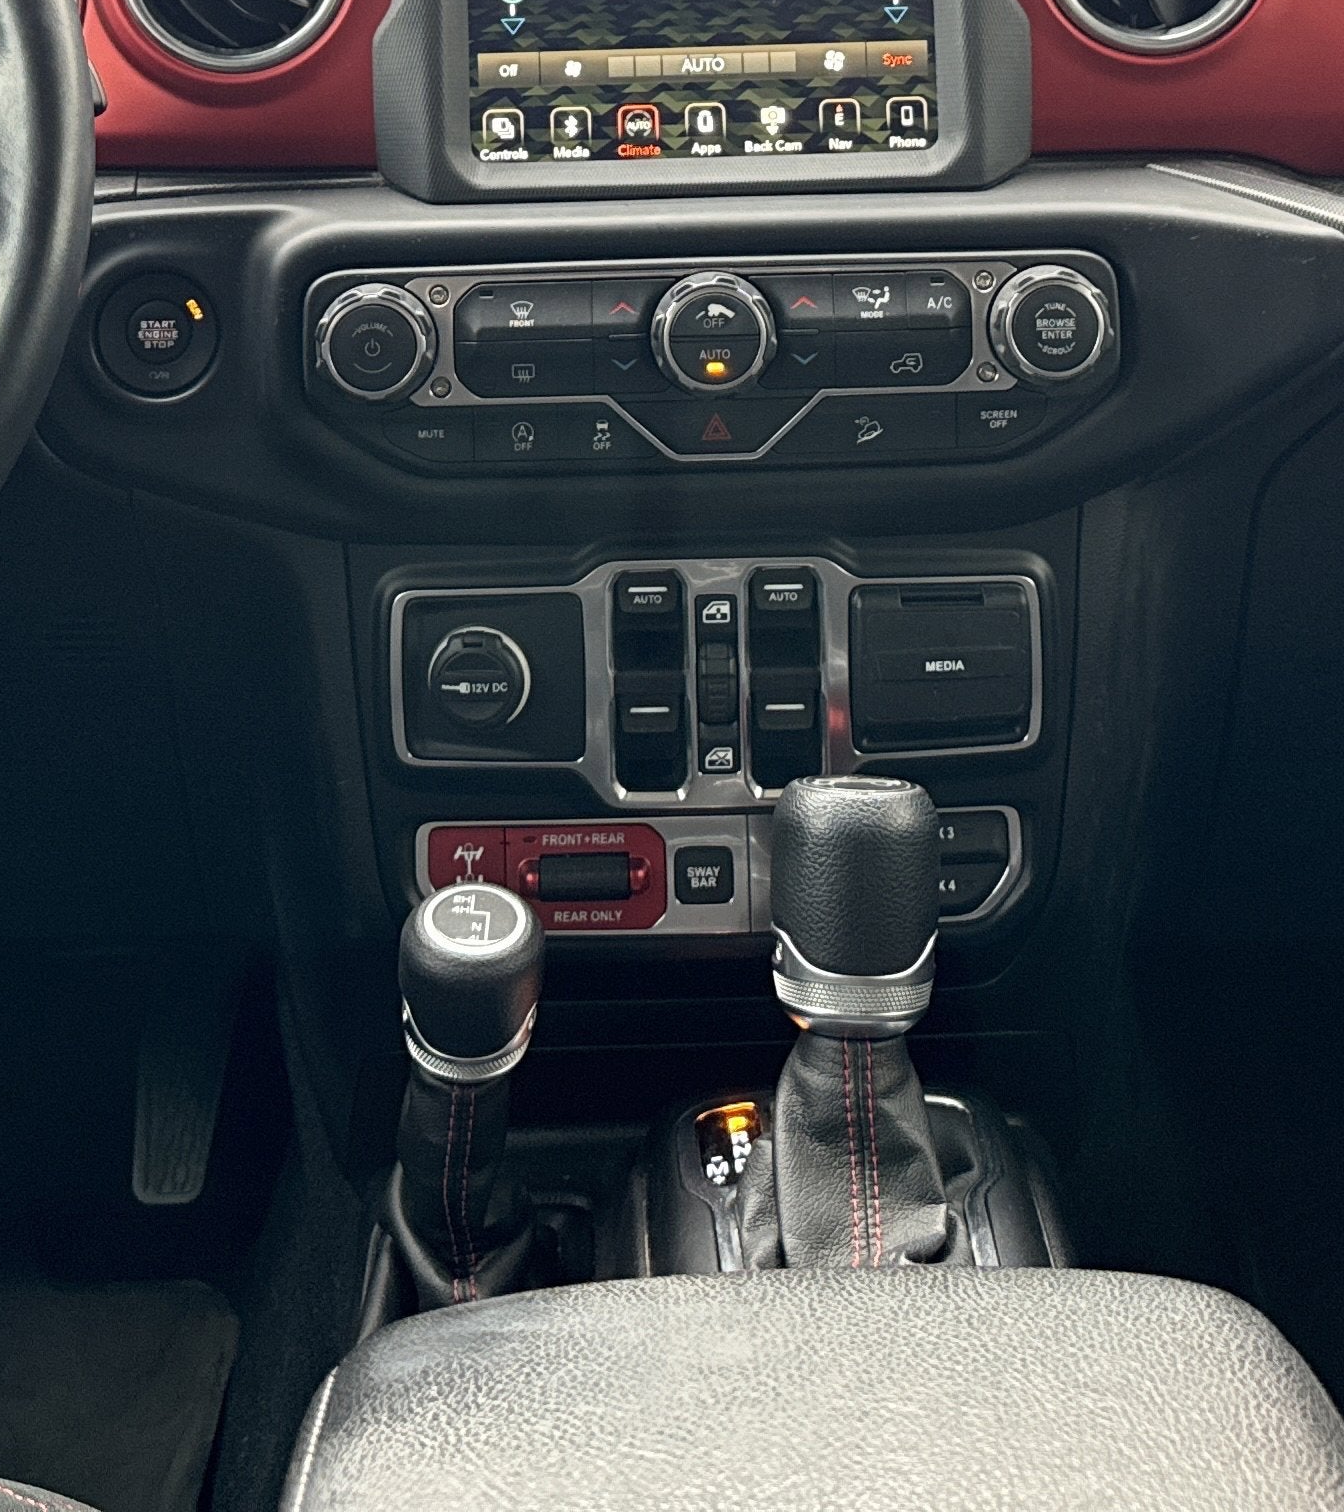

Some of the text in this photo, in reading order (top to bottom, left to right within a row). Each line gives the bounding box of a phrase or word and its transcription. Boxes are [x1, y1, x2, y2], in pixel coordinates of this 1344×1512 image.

[681, 56, 725, 73] AUTO
[881, 52, 913, 67] Sync
[499, 63, 518, 77] Off
[834, 112, 844, 126] E
[626, 120, 652, 131] AUTO
[744, 139, 803, 153] Back Cam
[828, 138, 853, 150] Nav
[889, 136, 927, 148] Phone
[479, 148, 529, 161] Controls
[553, 146, 591, 159] Media
[617, 144, 661, 157] Climate
[691, 142, 722, 156] Apps
[926, 296, 953, 310] A/C
[1044, 302, 1067, 311] TUNE
[860, 310, 884, 319] MODE
[140, 320, 177, 329] START
[355, 322, 389, 335] VOLUME
[509, 318, 535, 328] FRONT
[702, 317, 725, 329] OFF
[1035, 317, 1076, 328] BROWSE
[137, 330, 179, 339] ENGINE
[1040, 330, 1073, 340] ENTER
[143, 340, 175, 349] STOP
[1041, 344, 1073, 355] SCROLL
[698, 348, 731, 360] AUTO
[979, 409, 1018, 420] SCREEN
[989, 419, 1009, 429] OFF
[417, 428, 446, 440] MUTE
[514, 441, 533, 452] OFF
[592, 441, 612, 451] OFF
[633, 594, 663, 605] AUTO
[768, 591, 799, 602] AUTO
[924, 659, 966, 673] MEDIA
[471, 680, 509, 695] 12V DC
[947, 826, 955, 839] 3
[686, 866, 721, 879] SWAY
[690, 877, 717, 889] BAR
[948, 879, 957, 892] 4
[451, 905, 470, 914] 4H
[554, 910, 623, 923] REAR ONLY
[471, 921, 482, 932] N
[733, 1143, 752, 1158] N
[706, 1161, 729, 1179] M
